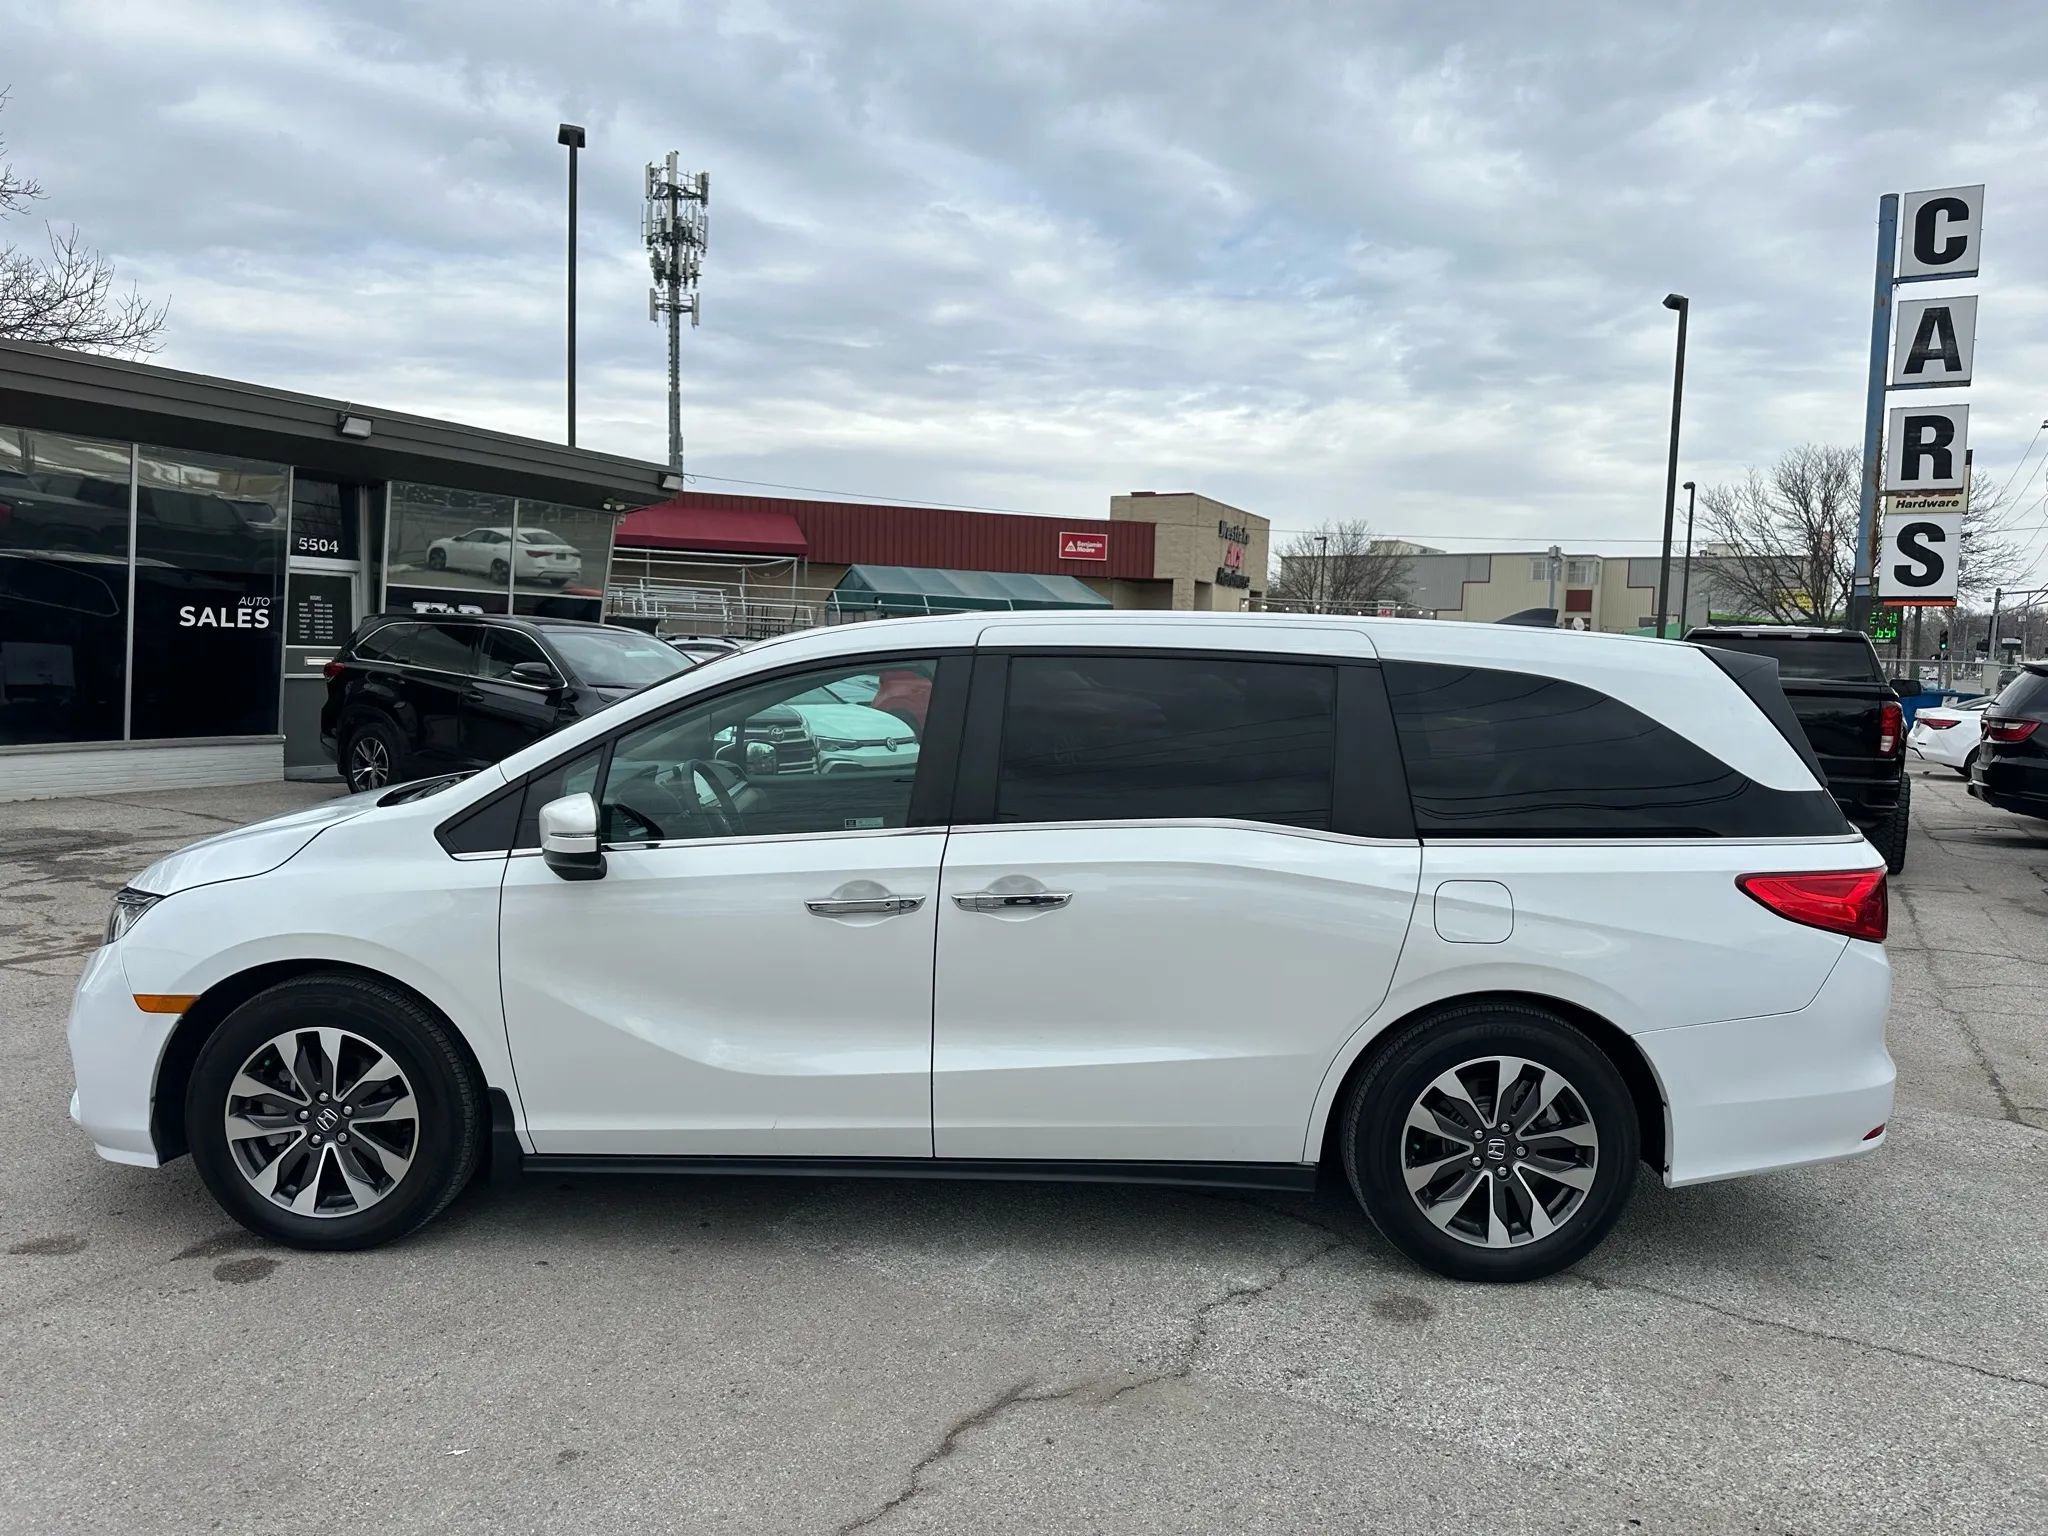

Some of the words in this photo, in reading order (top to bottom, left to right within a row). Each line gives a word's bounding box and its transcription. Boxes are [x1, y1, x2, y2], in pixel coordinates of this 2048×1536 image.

[1893, 196, 1970, 588] CARS
[1895, 499, 1960, 509] Hardware
[298, 537, 339, 553] 5504
[238, 596, 271, 607] AUTO
[179, 605, 270, 629] SALES
